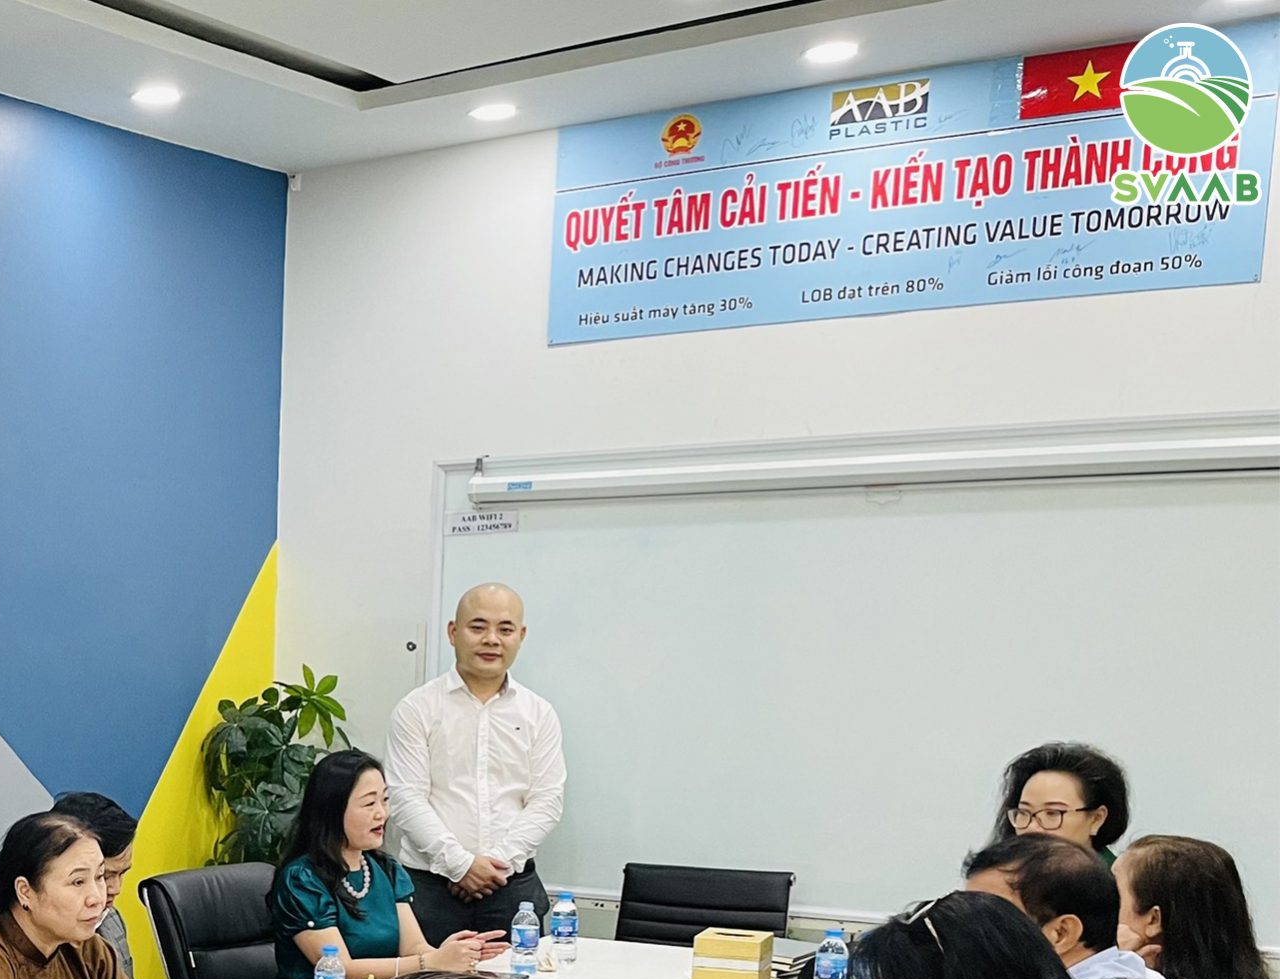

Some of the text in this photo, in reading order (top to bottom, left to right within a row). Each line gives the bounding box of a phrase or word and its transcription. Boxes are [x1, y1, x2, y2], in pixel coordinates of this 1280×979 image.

[833, 80, 926, 124] AAB
[829, 116, 927, 141] PLASTIC
[565, 190, 646, 251] QUYẾT
[654, 188, 711, 236] TÂM
[720, 173, 767, 228] CẢI
[776, 164, 841, 221] TIẾN
[871, 151, 944, 210] KIẾN
[955, 153, 1013, 207] TẠO
[1024, 136, 1132, 192] THÀNH
[577, 259, 658, 289] MAKING
[664, 247, 762, 278] CHANGES
[769, 238, 841, 266] TODAY
[862, 223, 977, 256] CREATING
[985, 213, 1063, 243] VALUE
[1071, 200, 1230, 234] TOMORROW
[1063, 264, 1104, 281] công
[1160, 253, 1203, 271] 50%
[801, 288, 833, 304] LOB
[868, 281, 900, 297] trên
[906, 277, 944, 294] 80%
[719, 297, 754, 313] 30%
